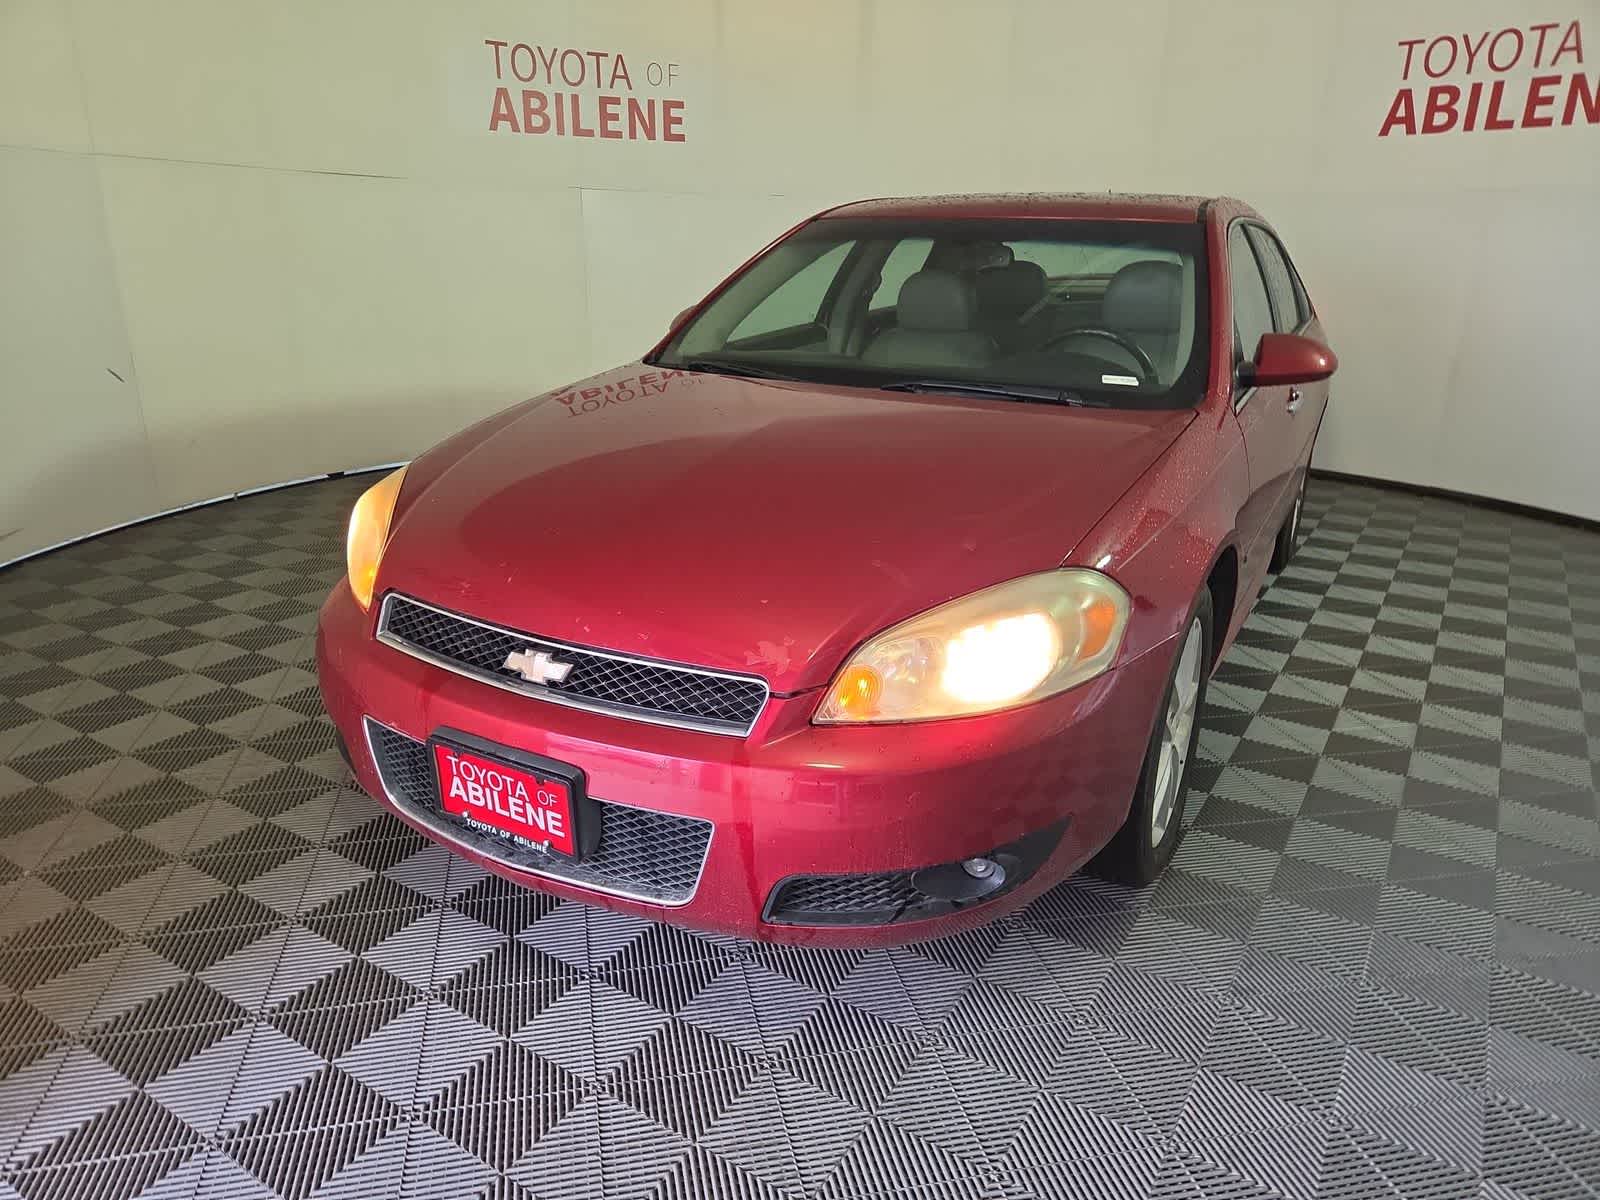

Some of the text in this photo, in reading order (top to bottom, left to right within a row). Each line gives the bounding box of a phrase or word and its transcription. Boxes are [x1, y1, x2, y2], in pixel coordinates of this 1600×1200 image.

[485, 39, 680, 90] TOYOTA OF
[1398, 19, 1583, 81] TOYOTA
[489, 87, 686, 142] ABILENE
[446, 755, 557, 807] TOYOTA OF
[450, 776, 565, 838] ABILENE
[466, 818, 548, 854] TOYOTA OF ABILENE
